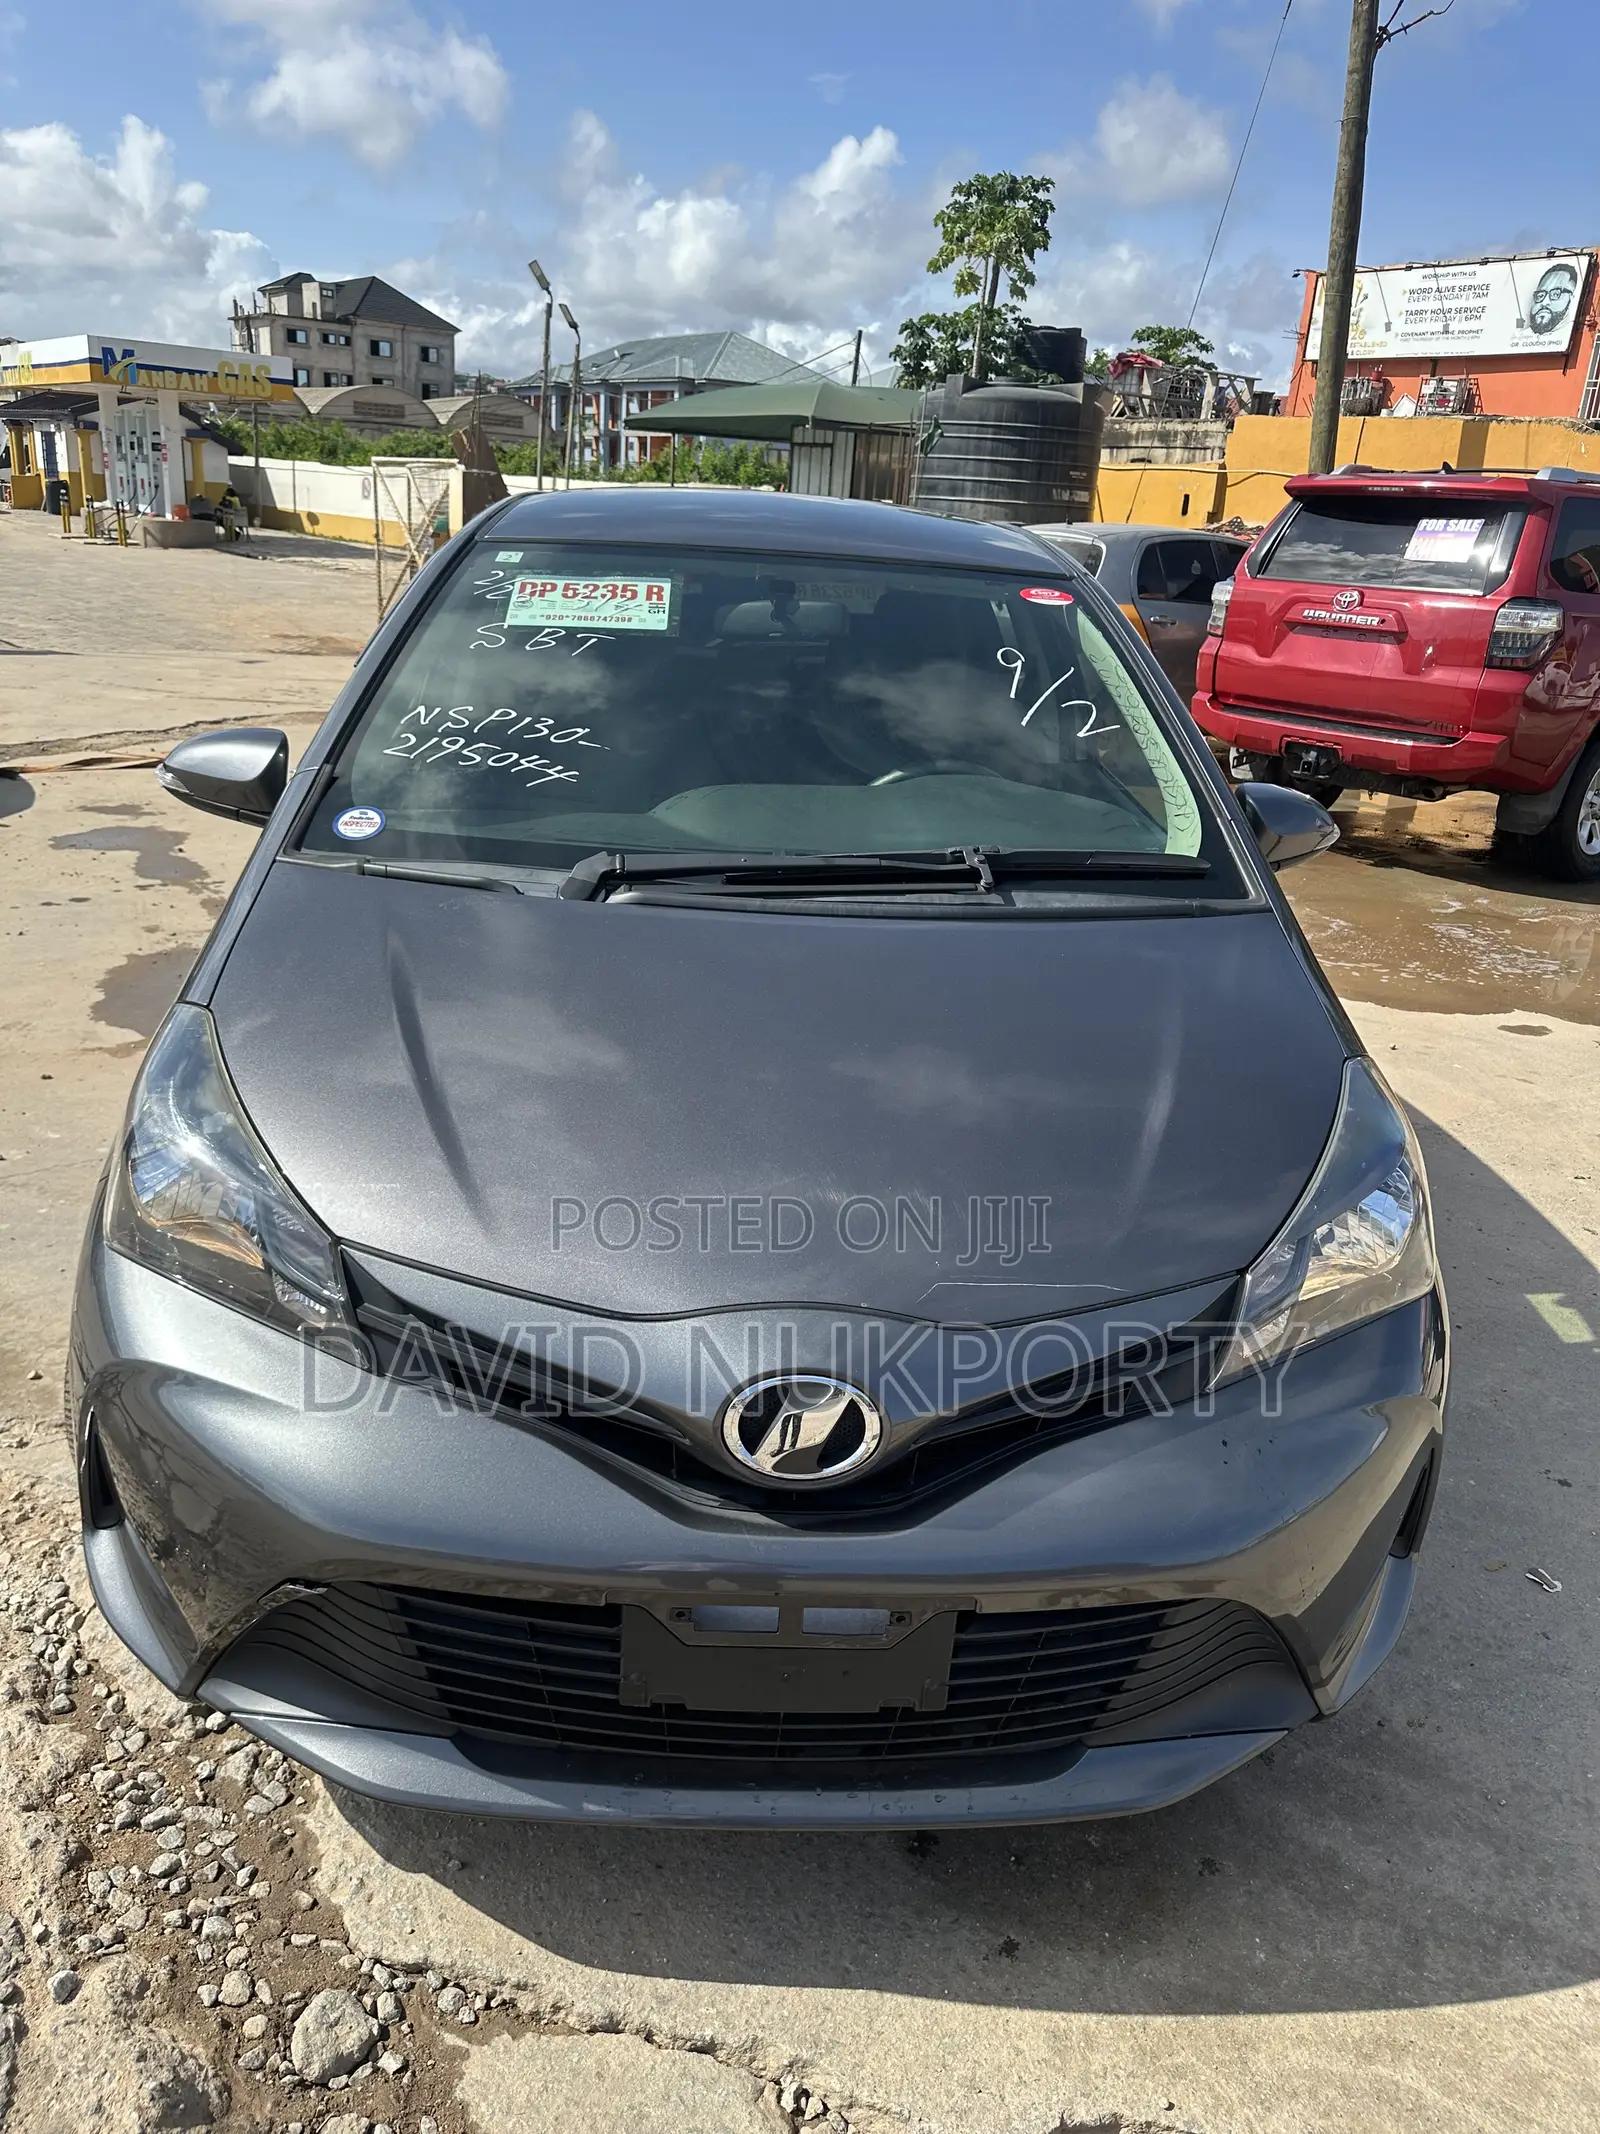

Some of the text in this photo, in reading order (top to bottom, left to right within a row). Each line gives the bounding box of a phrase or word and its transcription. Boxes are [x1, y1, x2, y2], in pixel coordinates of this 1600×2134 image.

[1422, 272, 1450, 280] WORSHIP
[1408, 283, 1491, 295] WORD ALIVE SERVICE
[1407, 294, 1432, 303] EVERY
[1432, 293, 1464, 302] SUNDAY
[1472, 291, 1489, 299] 7AM
[1405, 305, 1487, 317] TARRY HOUR SERVICE
[1404, 317, 1429, 325] EVERY
[1429, 315, 1458, 323] FRIDAY
[1464, 313, 1482, 322] 6PM
[1457, 328, 1484, 336] PROPHET
[217, 361, 272, 398] GAS
[1418, 518, 1481, 532] FOR SALE
[518, 581, 665, 602] DP 5235 R
[996, 647, 1121, 738] 9/2
[383, 733, 580, 787] 2195044
[340, 820, 379, 828] INSPECTED
